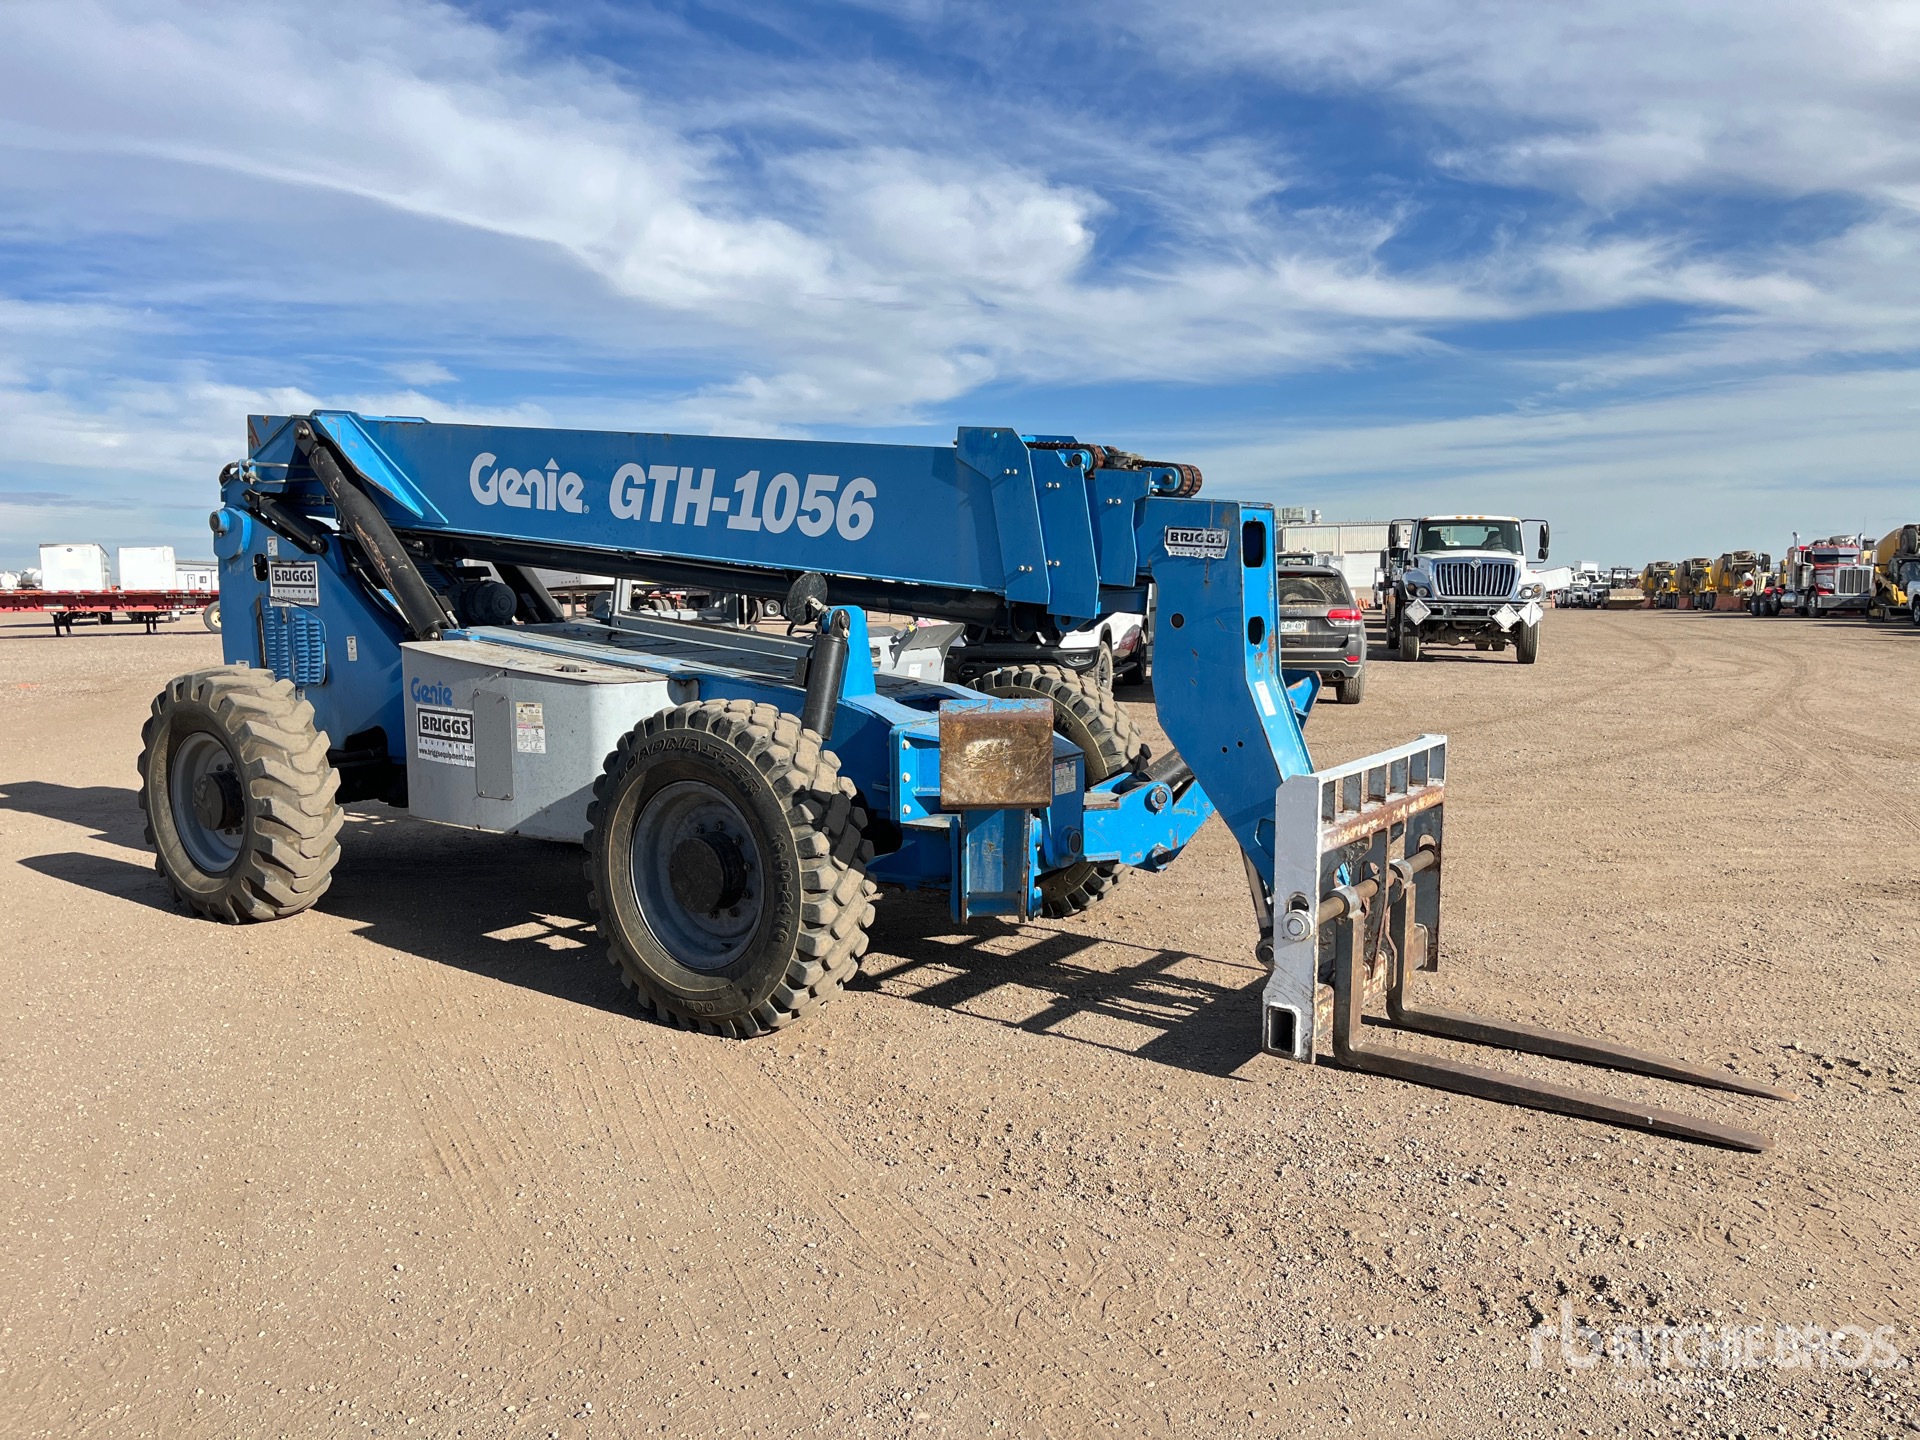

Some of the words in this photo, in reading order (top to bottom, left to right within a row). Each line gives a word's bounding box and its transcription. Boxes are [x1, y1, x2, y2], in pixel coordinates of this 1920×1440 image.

[469, 452, 584, 514] Genie
[609, 462, 877, 542] GTH-1056
[1170, 531, 1222, 544] BRIGGS
[274, 569, 313, 582] BRIGGS
[410, 677, 453, 706] Genie
[421, 715, 470, 736] BRIGGS
[618, 735, 762, 796] LOADMASTER
